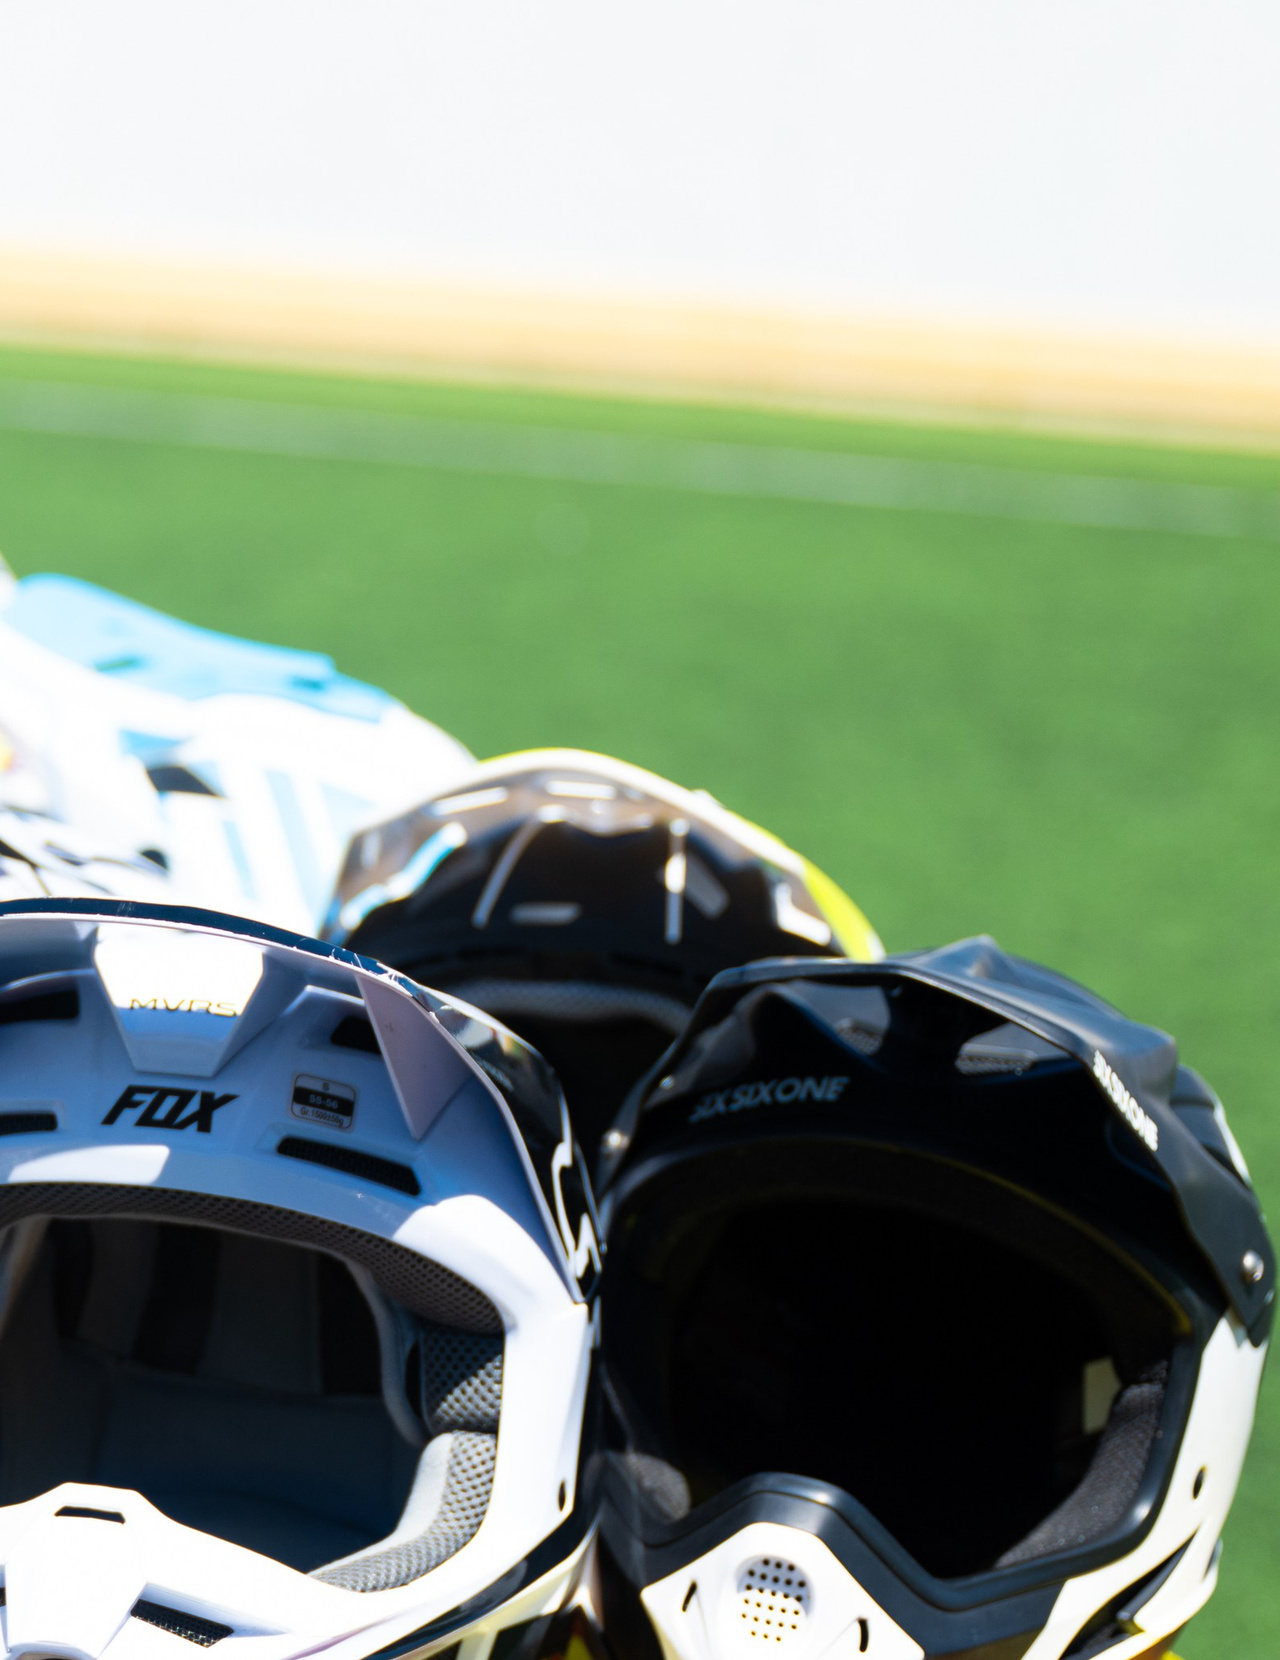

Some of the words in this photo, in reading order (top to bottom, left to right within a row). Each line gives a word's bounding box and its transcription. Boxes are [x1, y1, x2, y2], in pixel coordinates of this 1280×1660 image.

[129, 998, 238, 1018] MVRS
[101, 1084, 239, 1133] FOX
[309, 1094, 339, 1109] 55-56
[688, 1076, 851, 1123] SIXSIXONE
